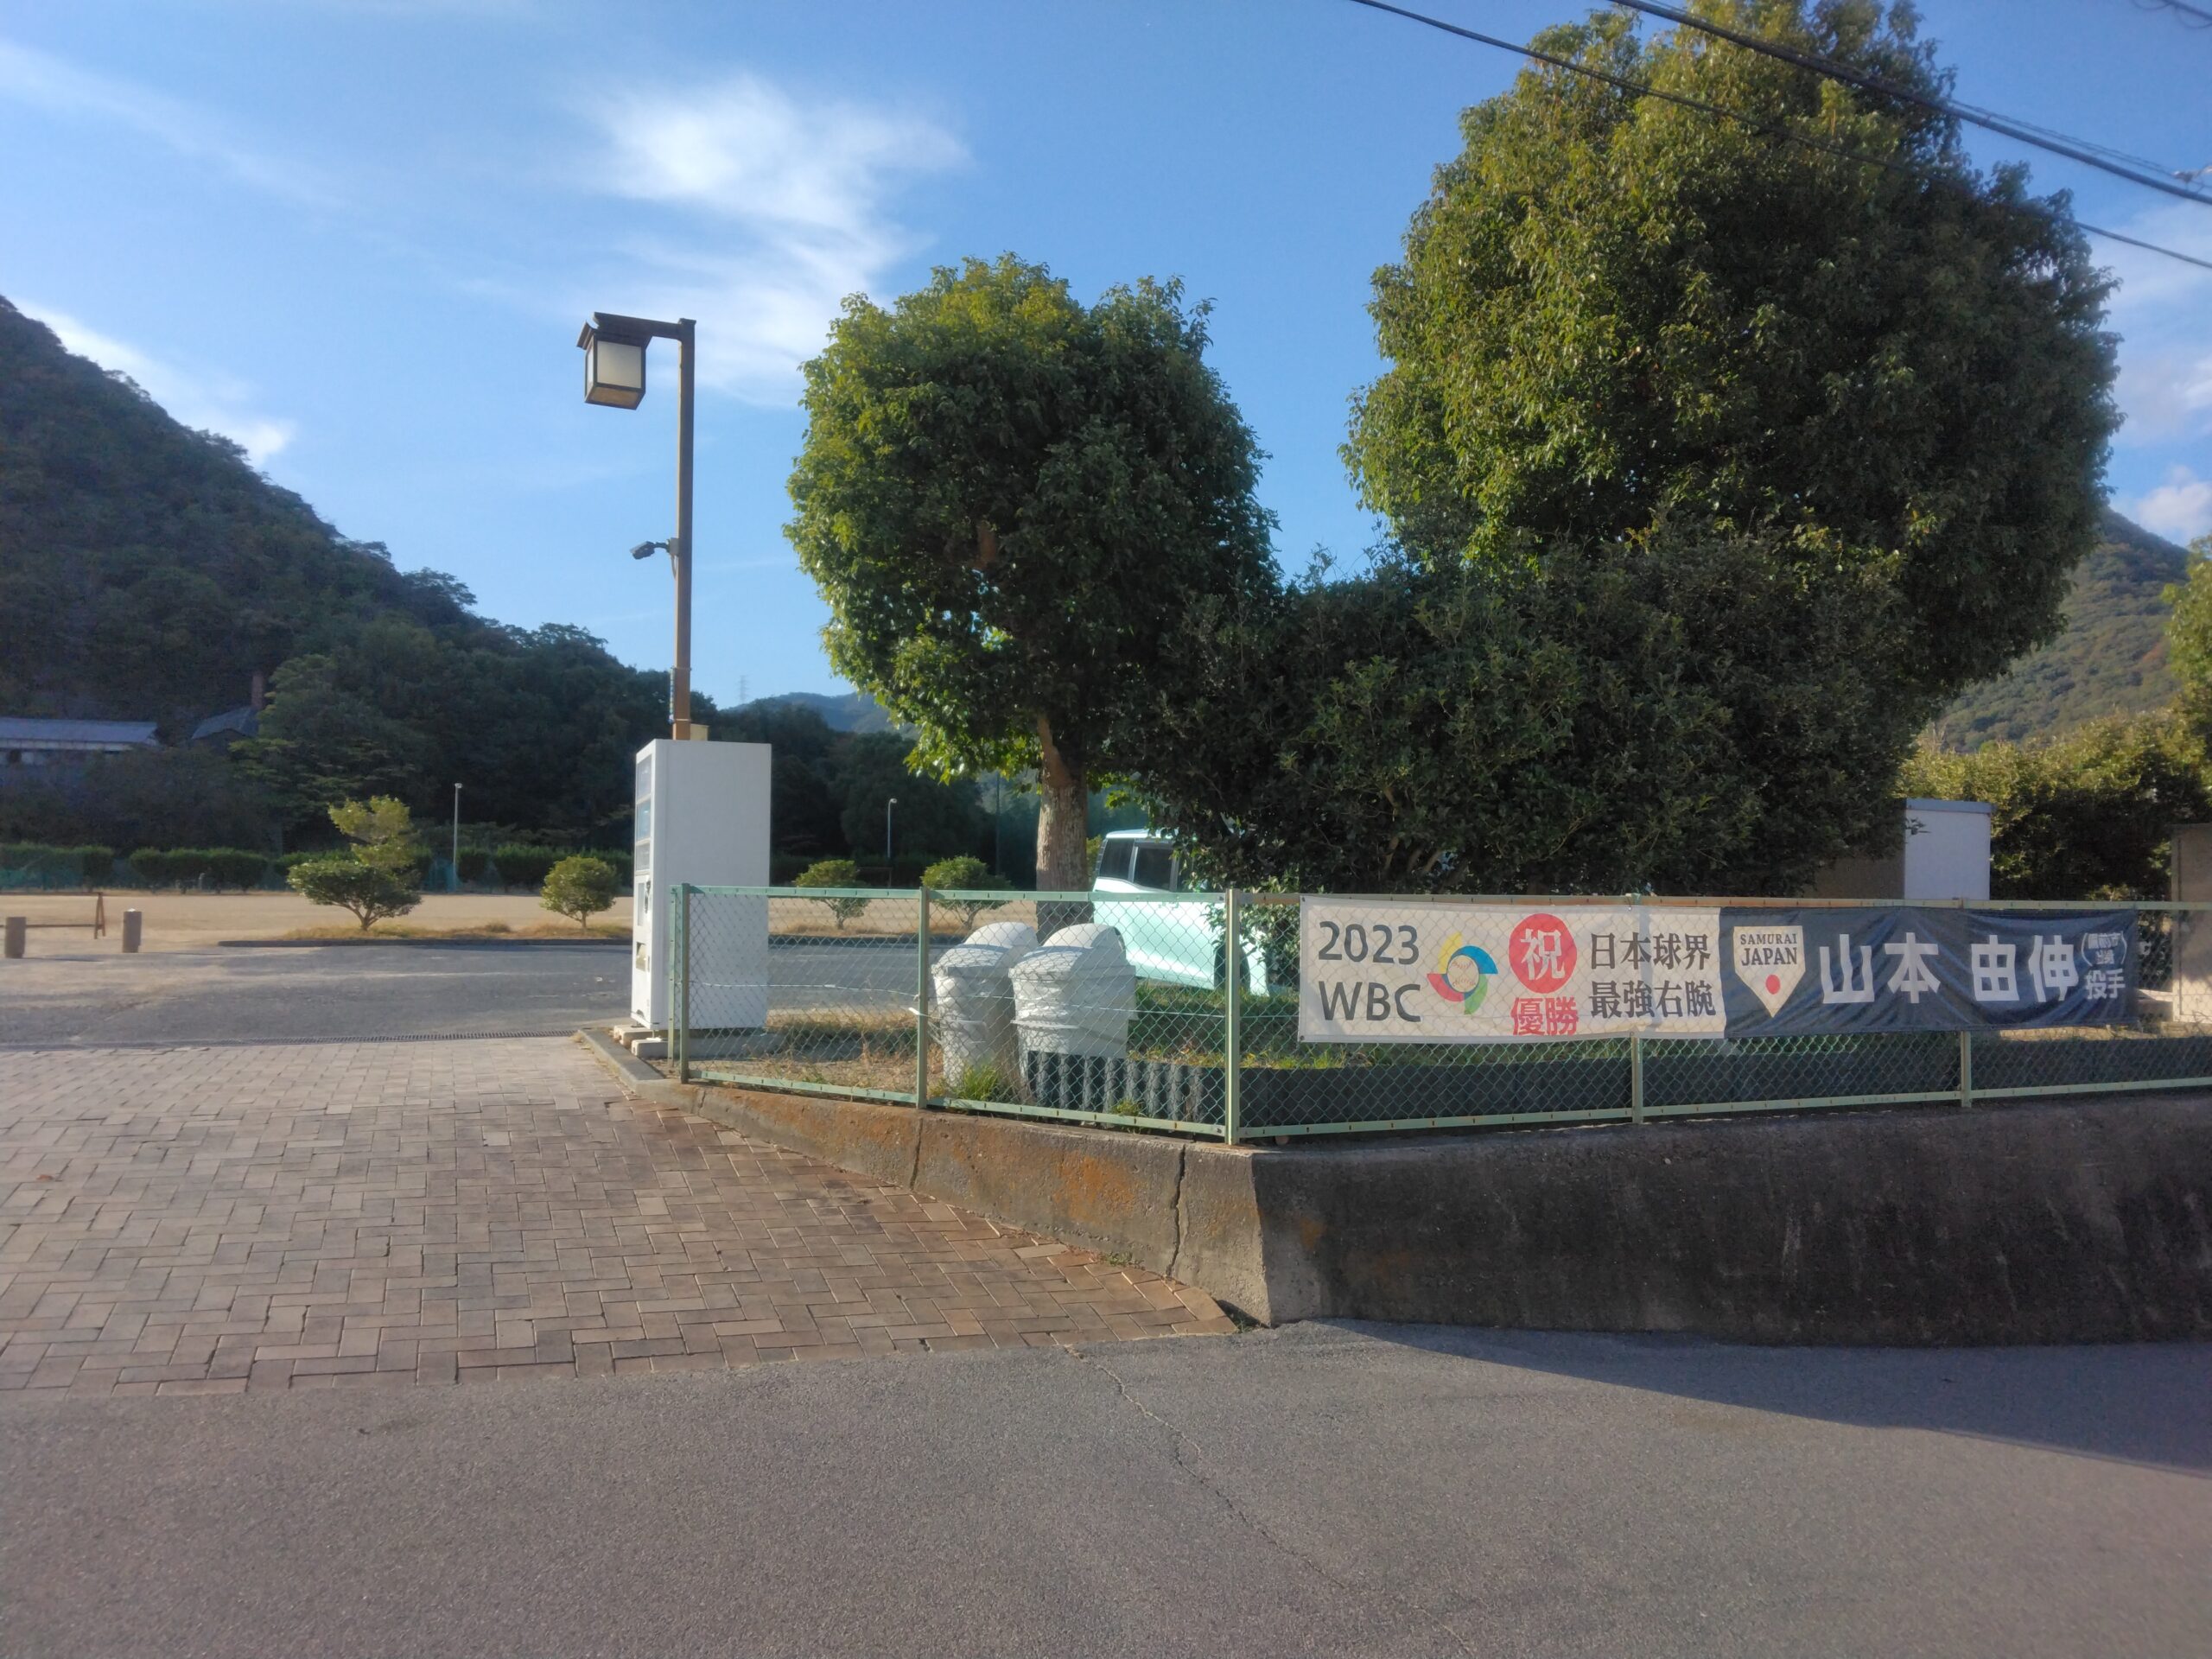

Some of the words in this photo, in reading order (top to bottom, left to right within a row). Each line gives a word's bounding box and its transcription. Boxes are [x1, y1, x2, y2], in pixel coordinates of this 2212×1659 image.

[1319, 921, 1420, 965] 2023
[1521, 928, 1566, 981] 祝
[1591, 931, 1711, 970] 日本球界
[1740, 933, 1797, 944] SAMURAI
[1741, 947, 1797, 966] JAPAN
[1820, 932, 2079, 1004] 山本由伸
[2085, 968, 2126, 1000] 投手
[1319, 982, 1421, 1022] WBC
[1510, 996, 1580, 1036] 優勝
[1588, 980, 1717, 1019] 最強右腕
